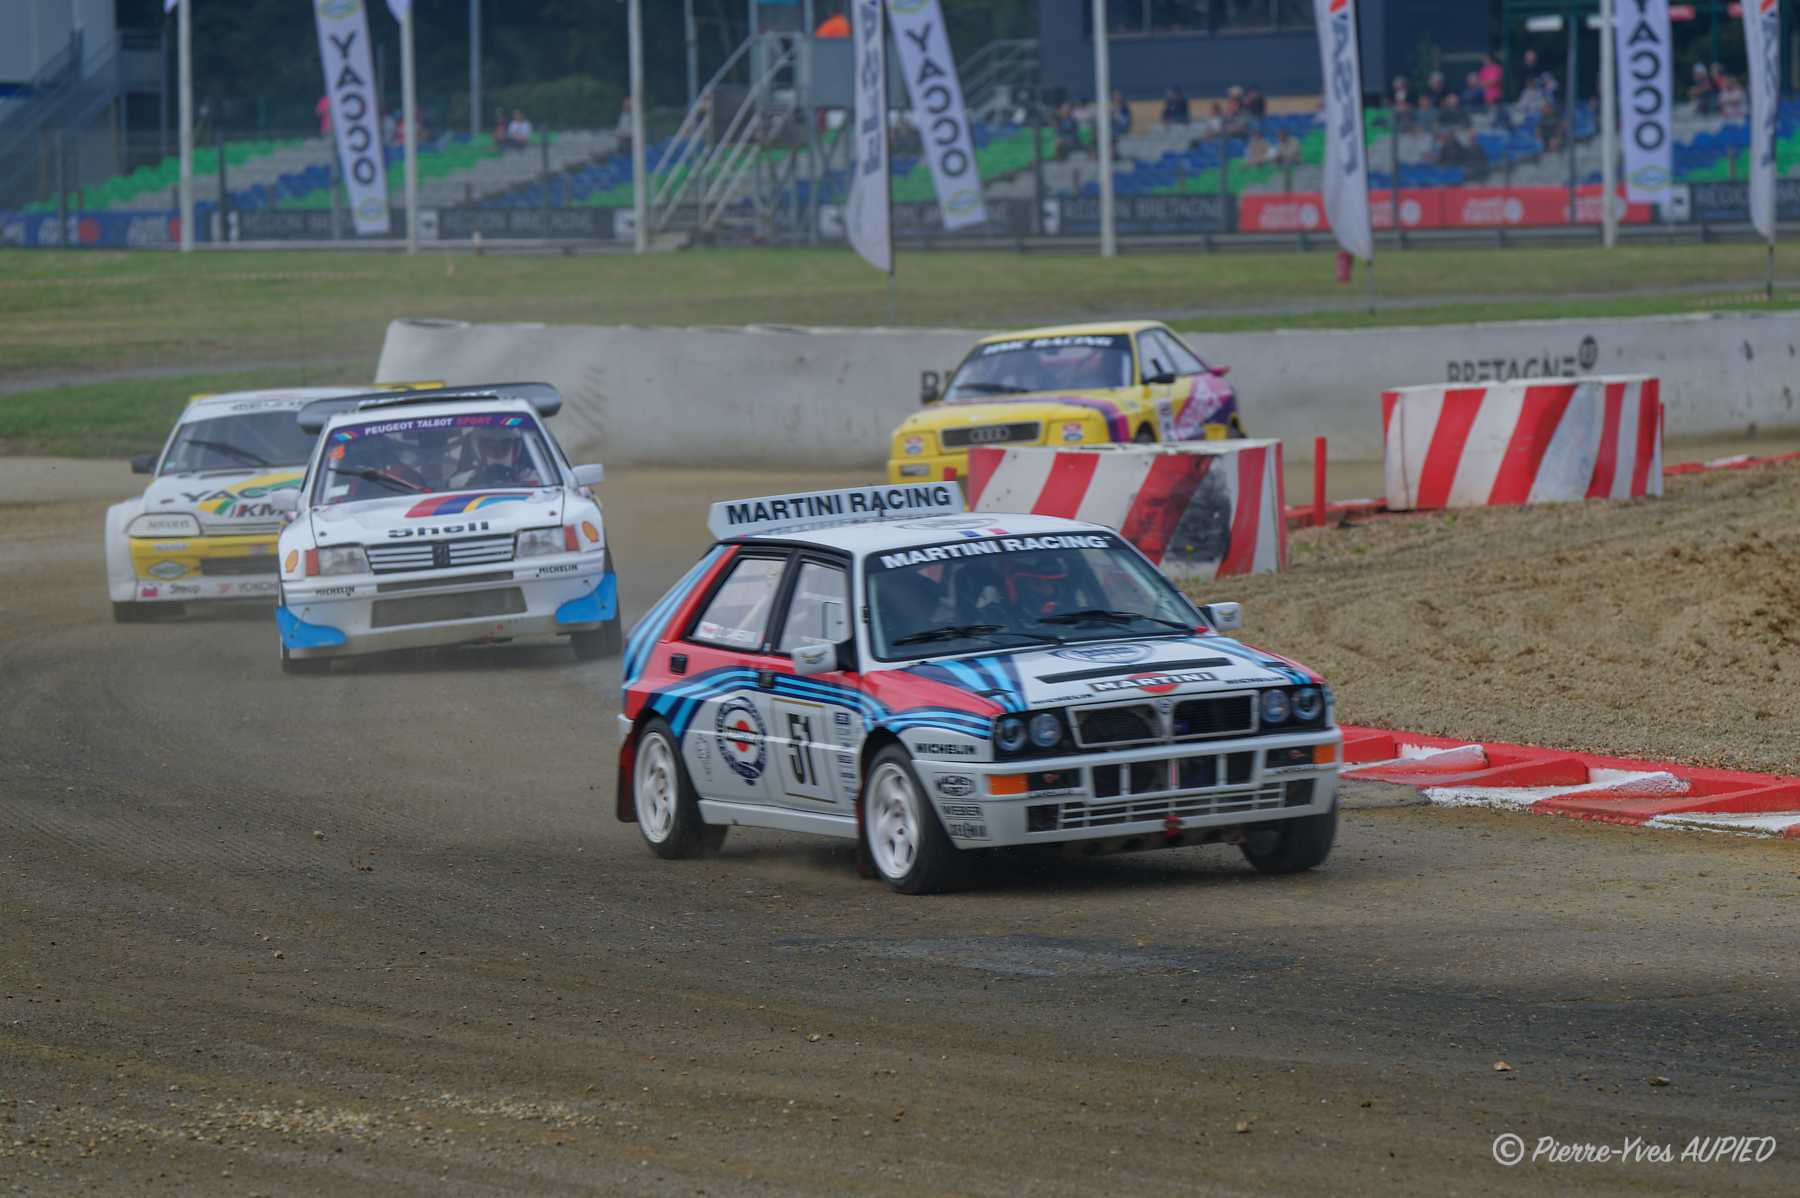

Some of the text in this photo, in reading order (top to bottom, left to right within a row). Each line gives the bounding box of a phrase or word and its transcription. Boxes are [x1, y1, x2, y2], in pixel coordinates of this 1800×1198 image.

[364, 415, 492, 436] PEUGEOT TALBOT SPORT
[727, 486, 951, 525] MARTINI RACING
[879, 535, 1109, 569] MARTINI RACING
[539, 564, 578, 574] MICHELIN
[315, 585, 355, 595] MICHELIN
[1094, 672, 1212, 692] MARTINI
[786, 713, 818, 786] 51
[915, 743, 977, 755] MICHELIN
